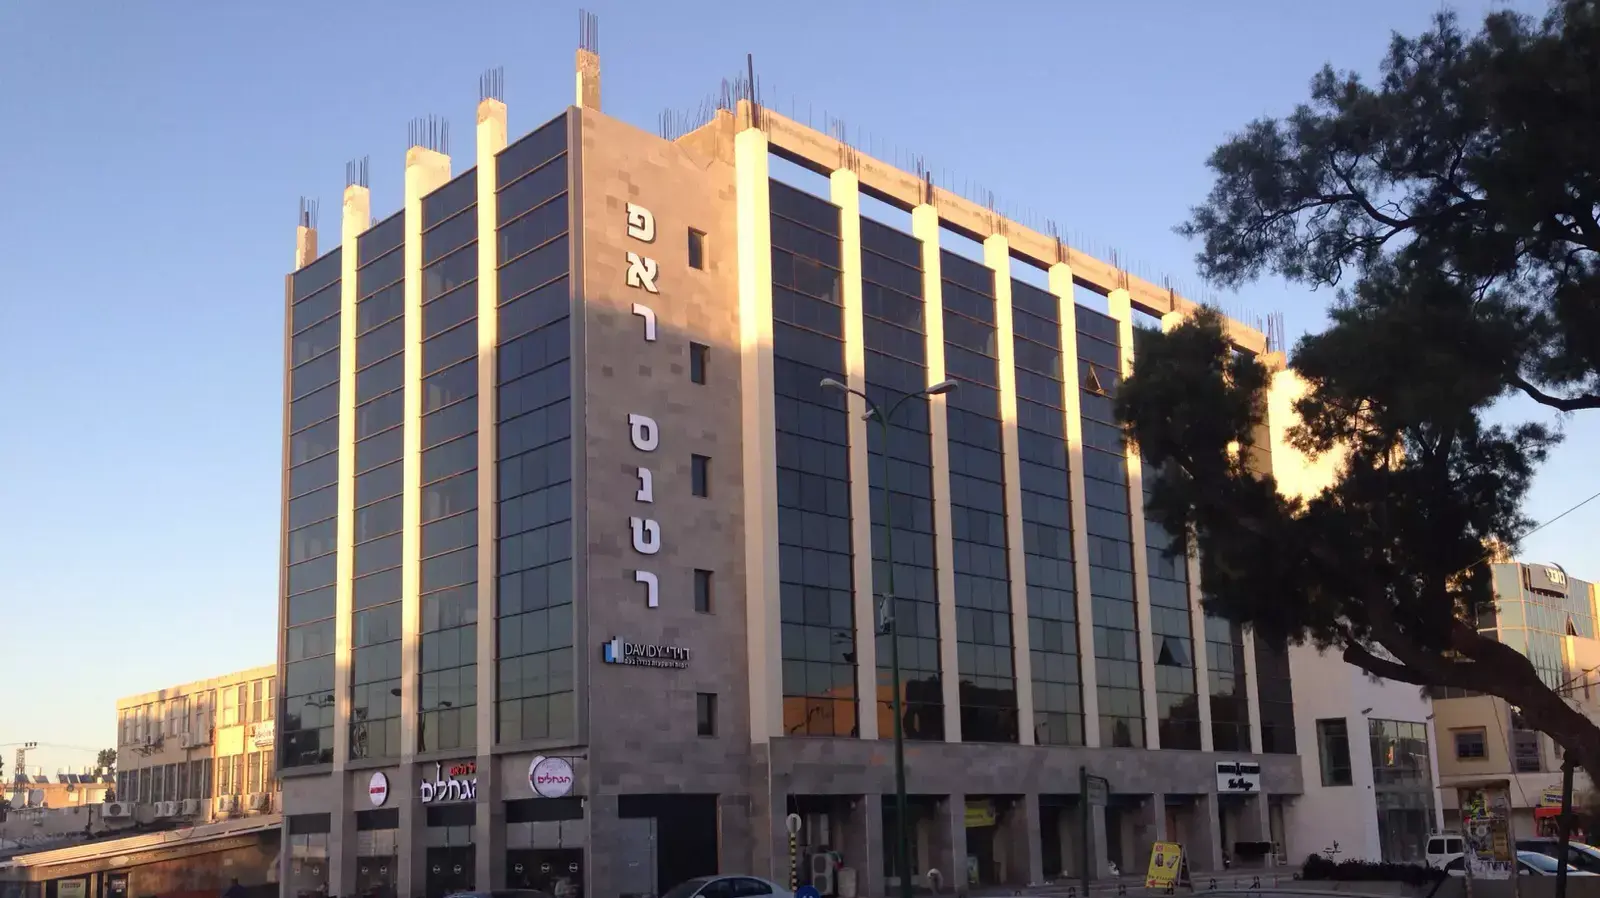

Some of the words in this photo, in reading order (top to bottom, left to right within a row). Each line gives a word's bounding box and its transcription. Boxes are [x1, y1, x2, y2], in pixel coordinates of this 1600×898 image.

[626, 202, 658, 341] פאר
[629, 414, 660, 608] סנטר
[624, 642, 663, 658] DAVIDY
